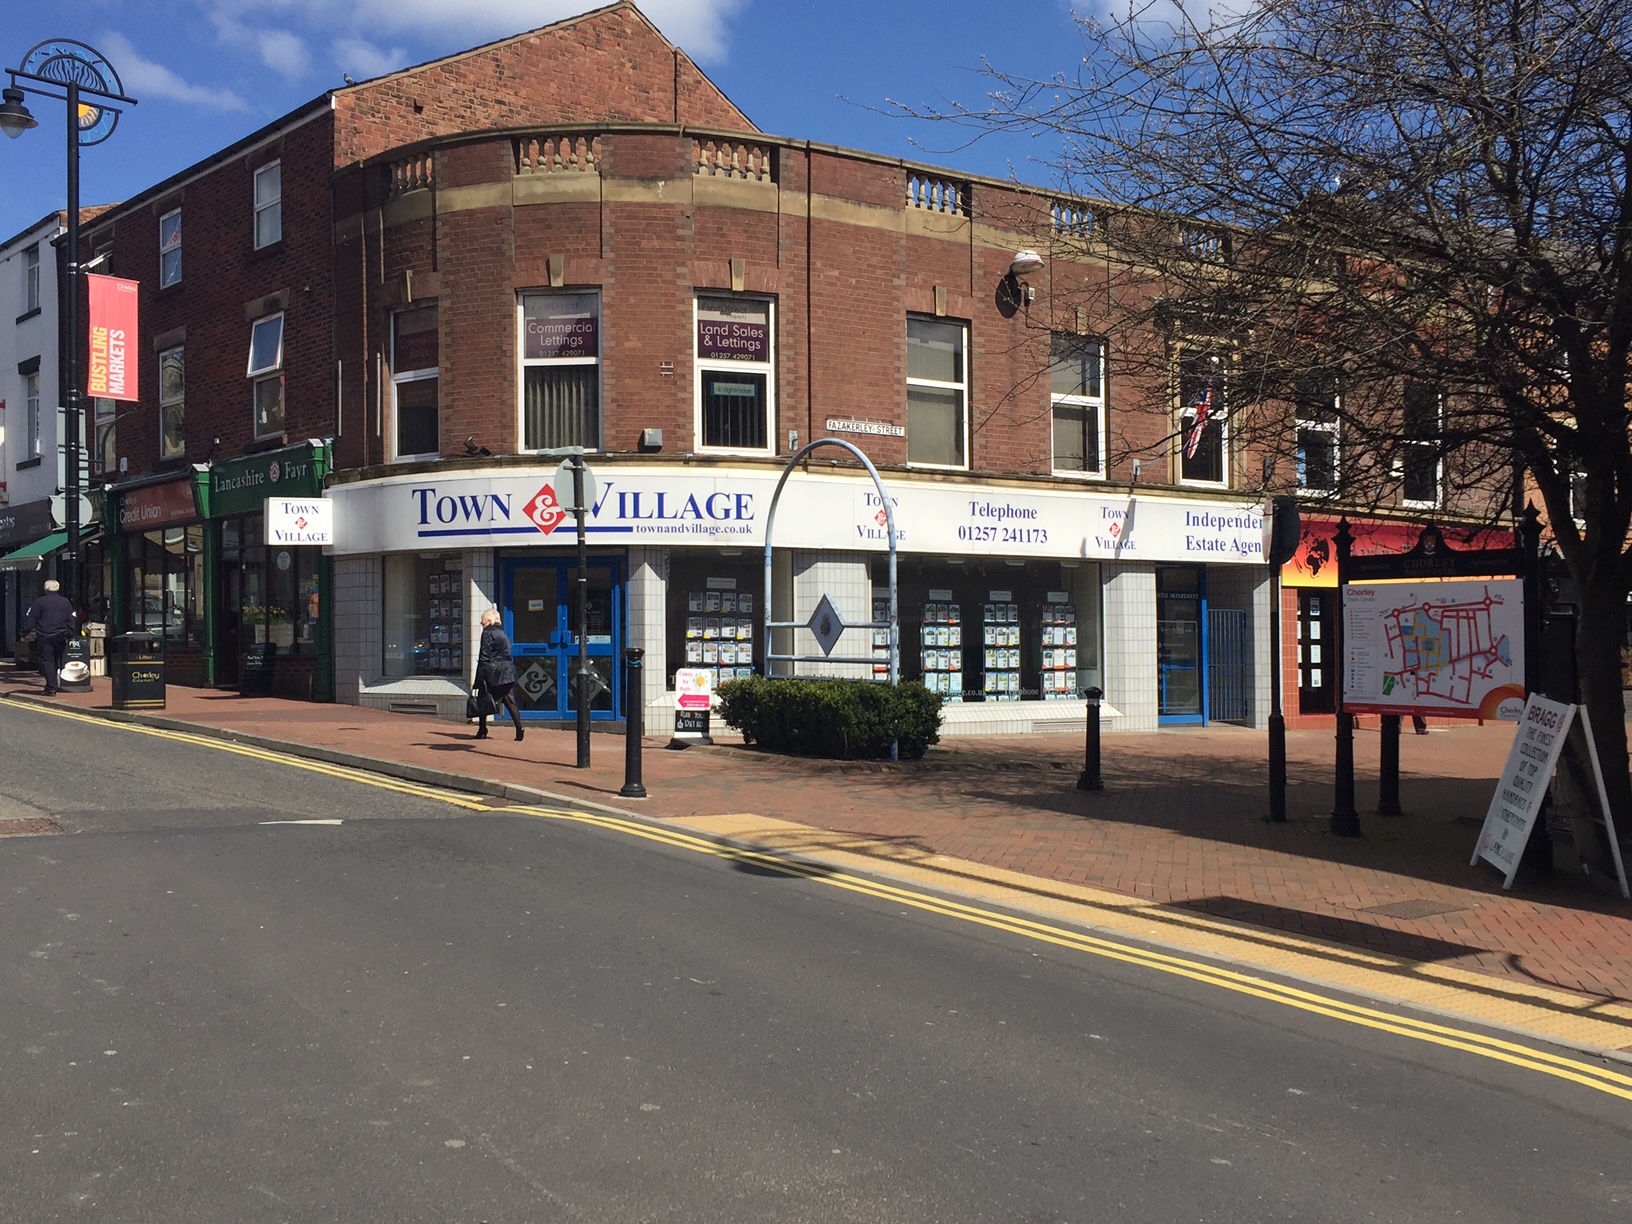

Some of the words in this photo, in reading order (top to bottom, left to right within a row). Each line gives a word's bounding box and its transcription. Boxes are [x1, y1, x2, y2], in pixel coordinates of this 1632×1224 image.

[700, 323, 728, 335] Land
[733, 325, 763, 338] Sales
[540, 334, 584, 347] Lettings
[704, 335, 713, 346] &
[717, 336, 761, 351] Lettings
[90, 326, 108, 392] BUSTLING
[109, 329, 125, 394] MARKETS
[829, 421, 873, 432] FAZAKERLEY
[877, 426, 902, 435] STREET
[215, 469, 264, 492] Lancashire
[284, 462, 307, 480] Fayr
[412, 488, 512, 524] TOWN
[533, 495, 561, 526] &
[864, 492, 898, 507] TON
[120, 508, 140, 523] Credit
[141, 504, 161, 519] Union
[282, 503, 319, 515] TOWN
[969, 501, 1037, 521] Telephone
[1101, 507, 1130, 519] TOWN
[636, 524, 753, 535] townandvillage.co.uk
[1186, 511, 1263, 531] Independe
[275, 530, 328, 542] VILLAGE
[958, 525, 997, 541] 01257
[1002, 527, 1048, 543] 241173
[1095, 536, 1136, 550] VILLAGE
[1186, 535, 1226, 551] Estate
[1229, 537, 1261, 556] Agen
[1404, 559, 1455, 568] CHORLEY
[1347, 589, 1375, 597] Chorley
[132, 671, 160, 680] Chorley
[525, 671, 548, 693] &
[1527, 705, 1557, 729] BRAGG
[1527, 727, 1537, 740] THE
[1537, 731, 1554, 747] FINEST
[1520, 742, 1549, 763] COLLECTION
[1519, 760, 1528, 772] OF
[1527, 763, 1538, 777] TOP
[1513, 775, 1534, 793] QUALITY
